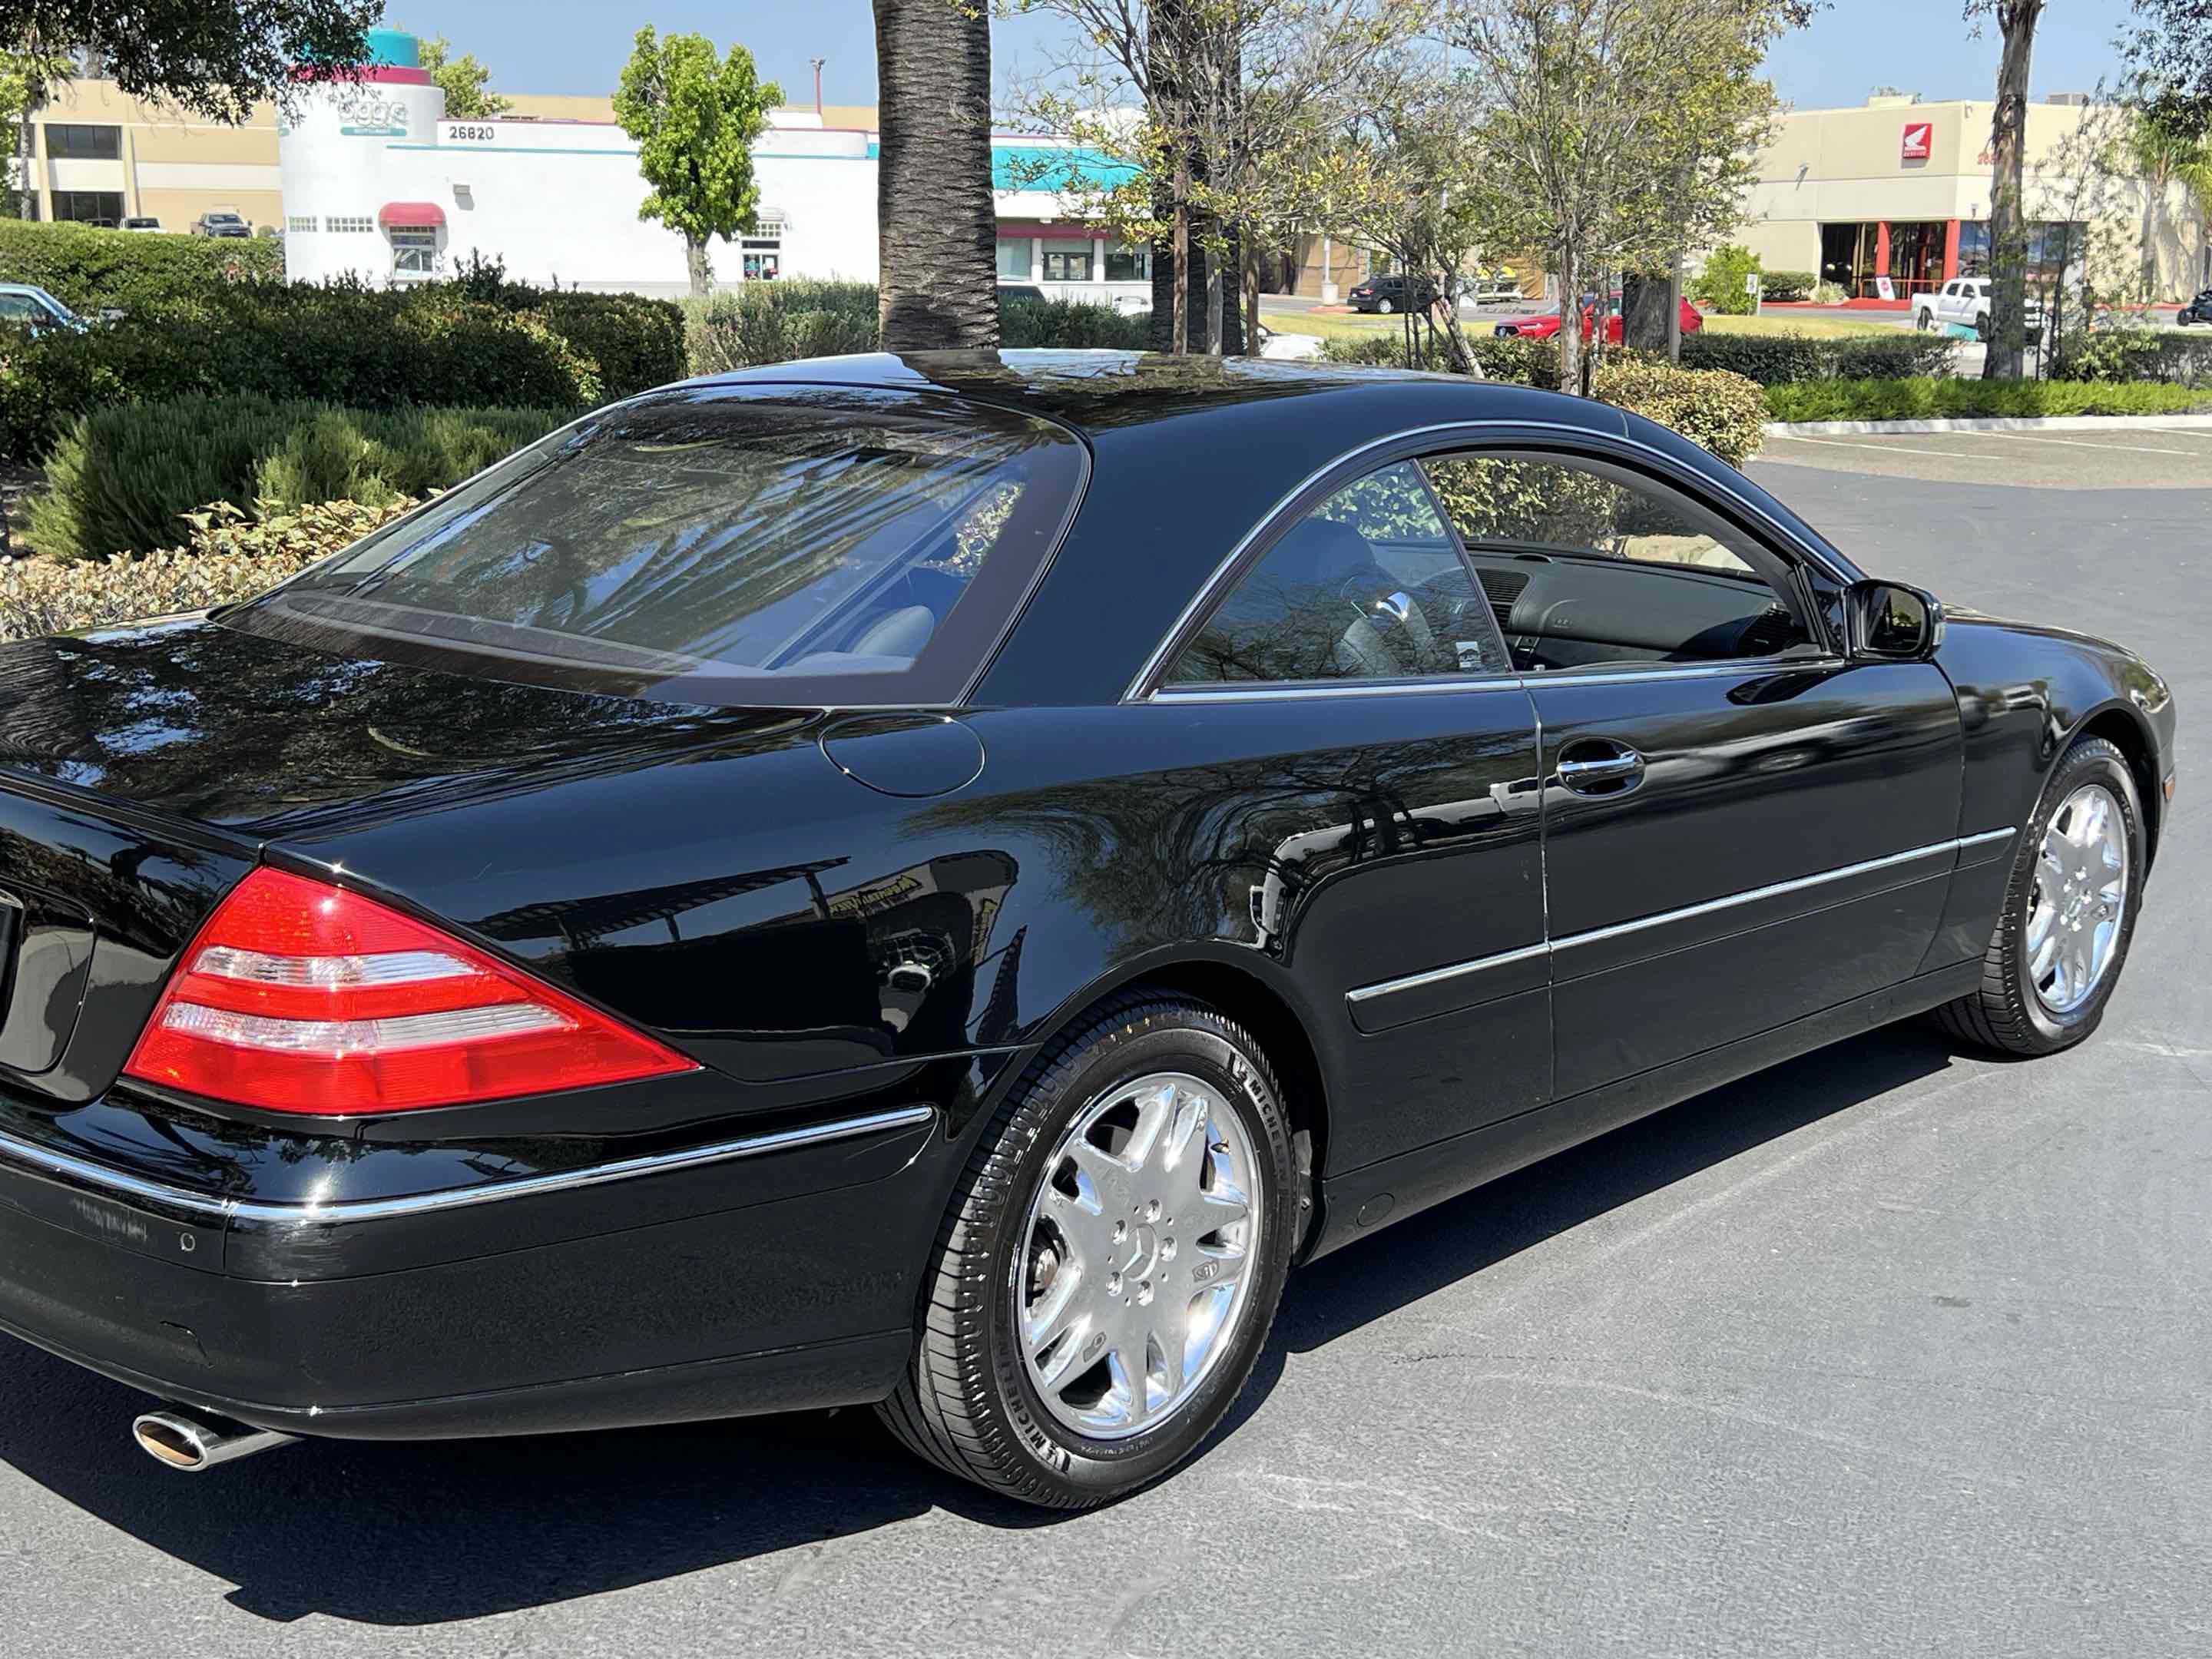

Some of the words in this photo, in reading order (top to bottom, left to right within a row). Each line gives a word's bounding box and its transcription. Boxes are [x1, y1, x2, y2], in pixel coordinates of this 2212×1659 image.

[449, 126, 495, 141] 26820
[1249, 1078, 1287, 1181] MICHELIN
[1000, 1346, 1046, 1450] MICHELIN
